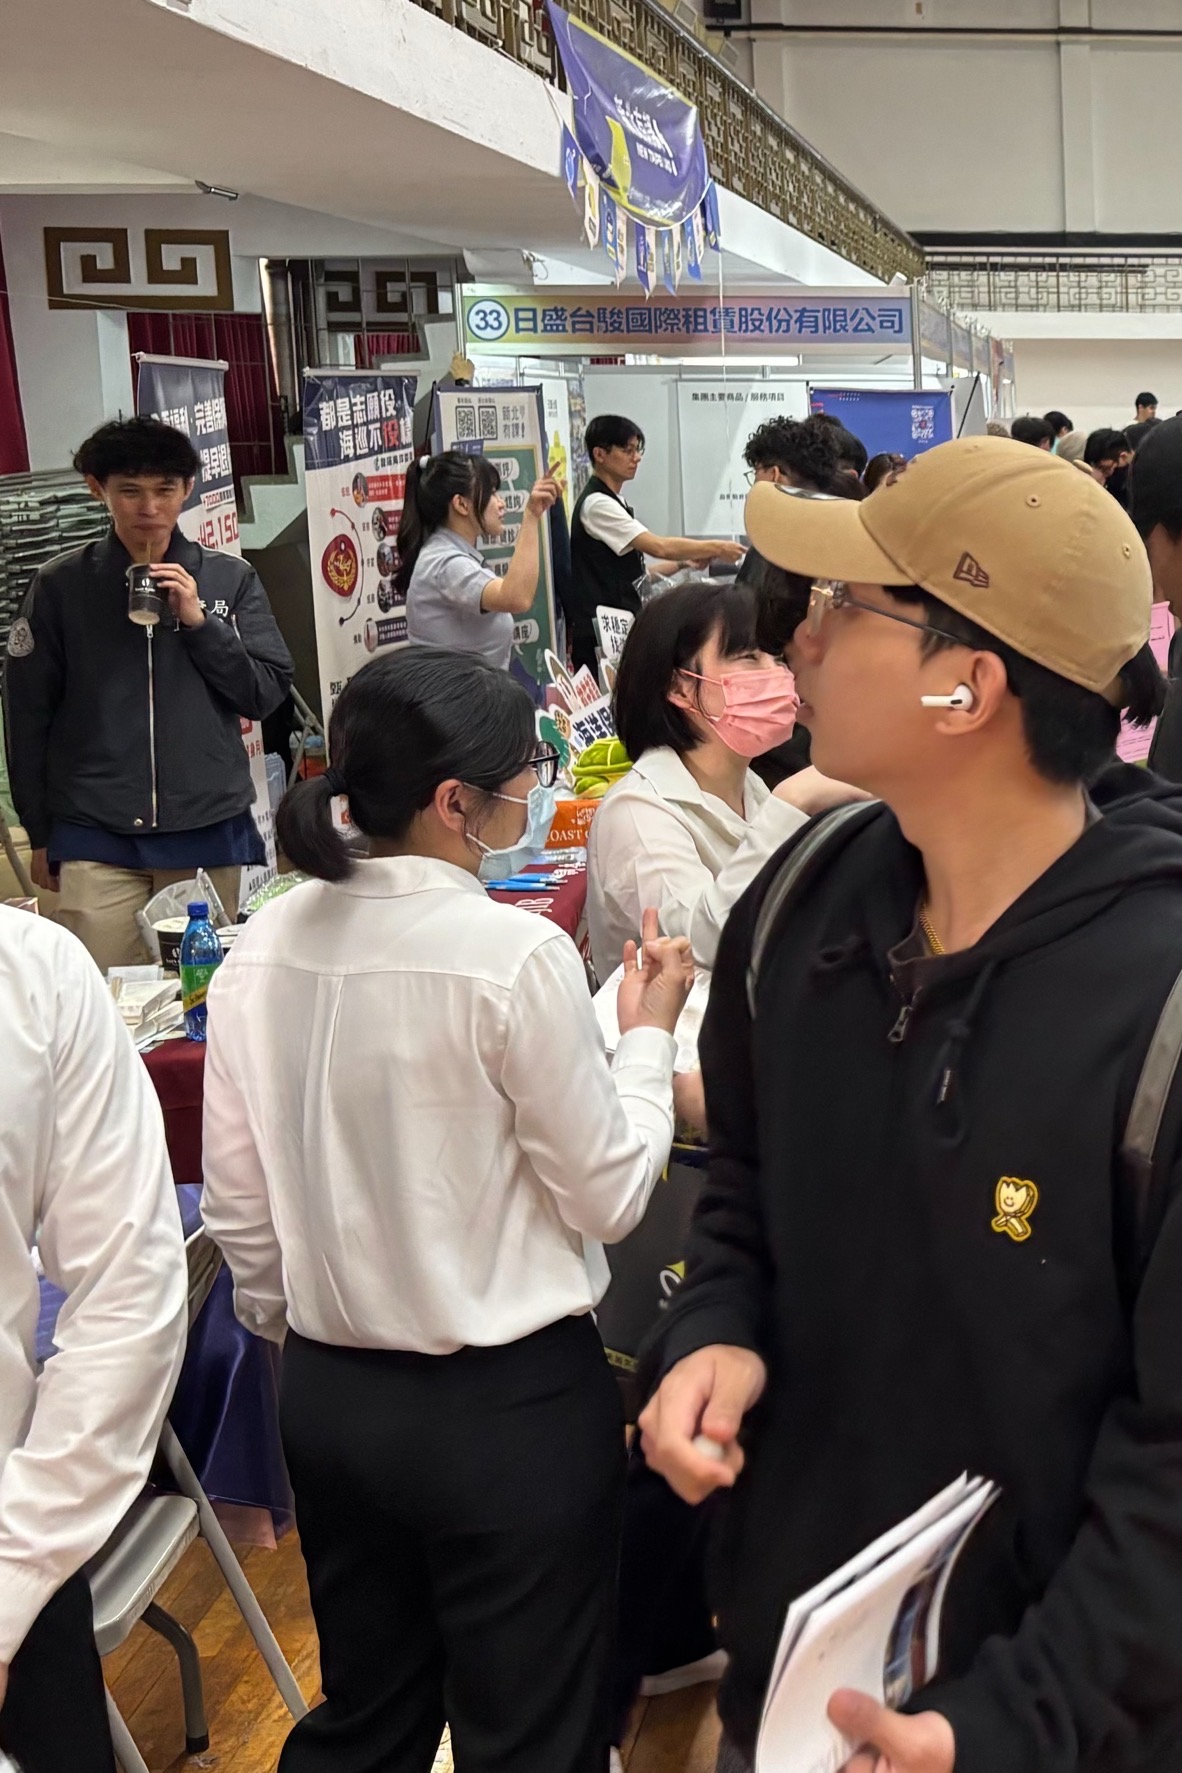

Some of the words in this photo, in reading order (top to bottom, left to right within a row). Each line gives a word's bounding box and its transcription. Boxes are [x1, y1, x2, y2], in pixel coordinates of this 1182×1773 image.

[475, 309, 503, 331] 33
[514, 307, 903, 335] 日盛台駿國際租賃股份有限公司
[318, 388, 397, 431] 都是志願役
[199, 442, 232, 483] 提早退
[601, 613, 629, 635] 求穩定
[546, 829, 583, 842] OAST
